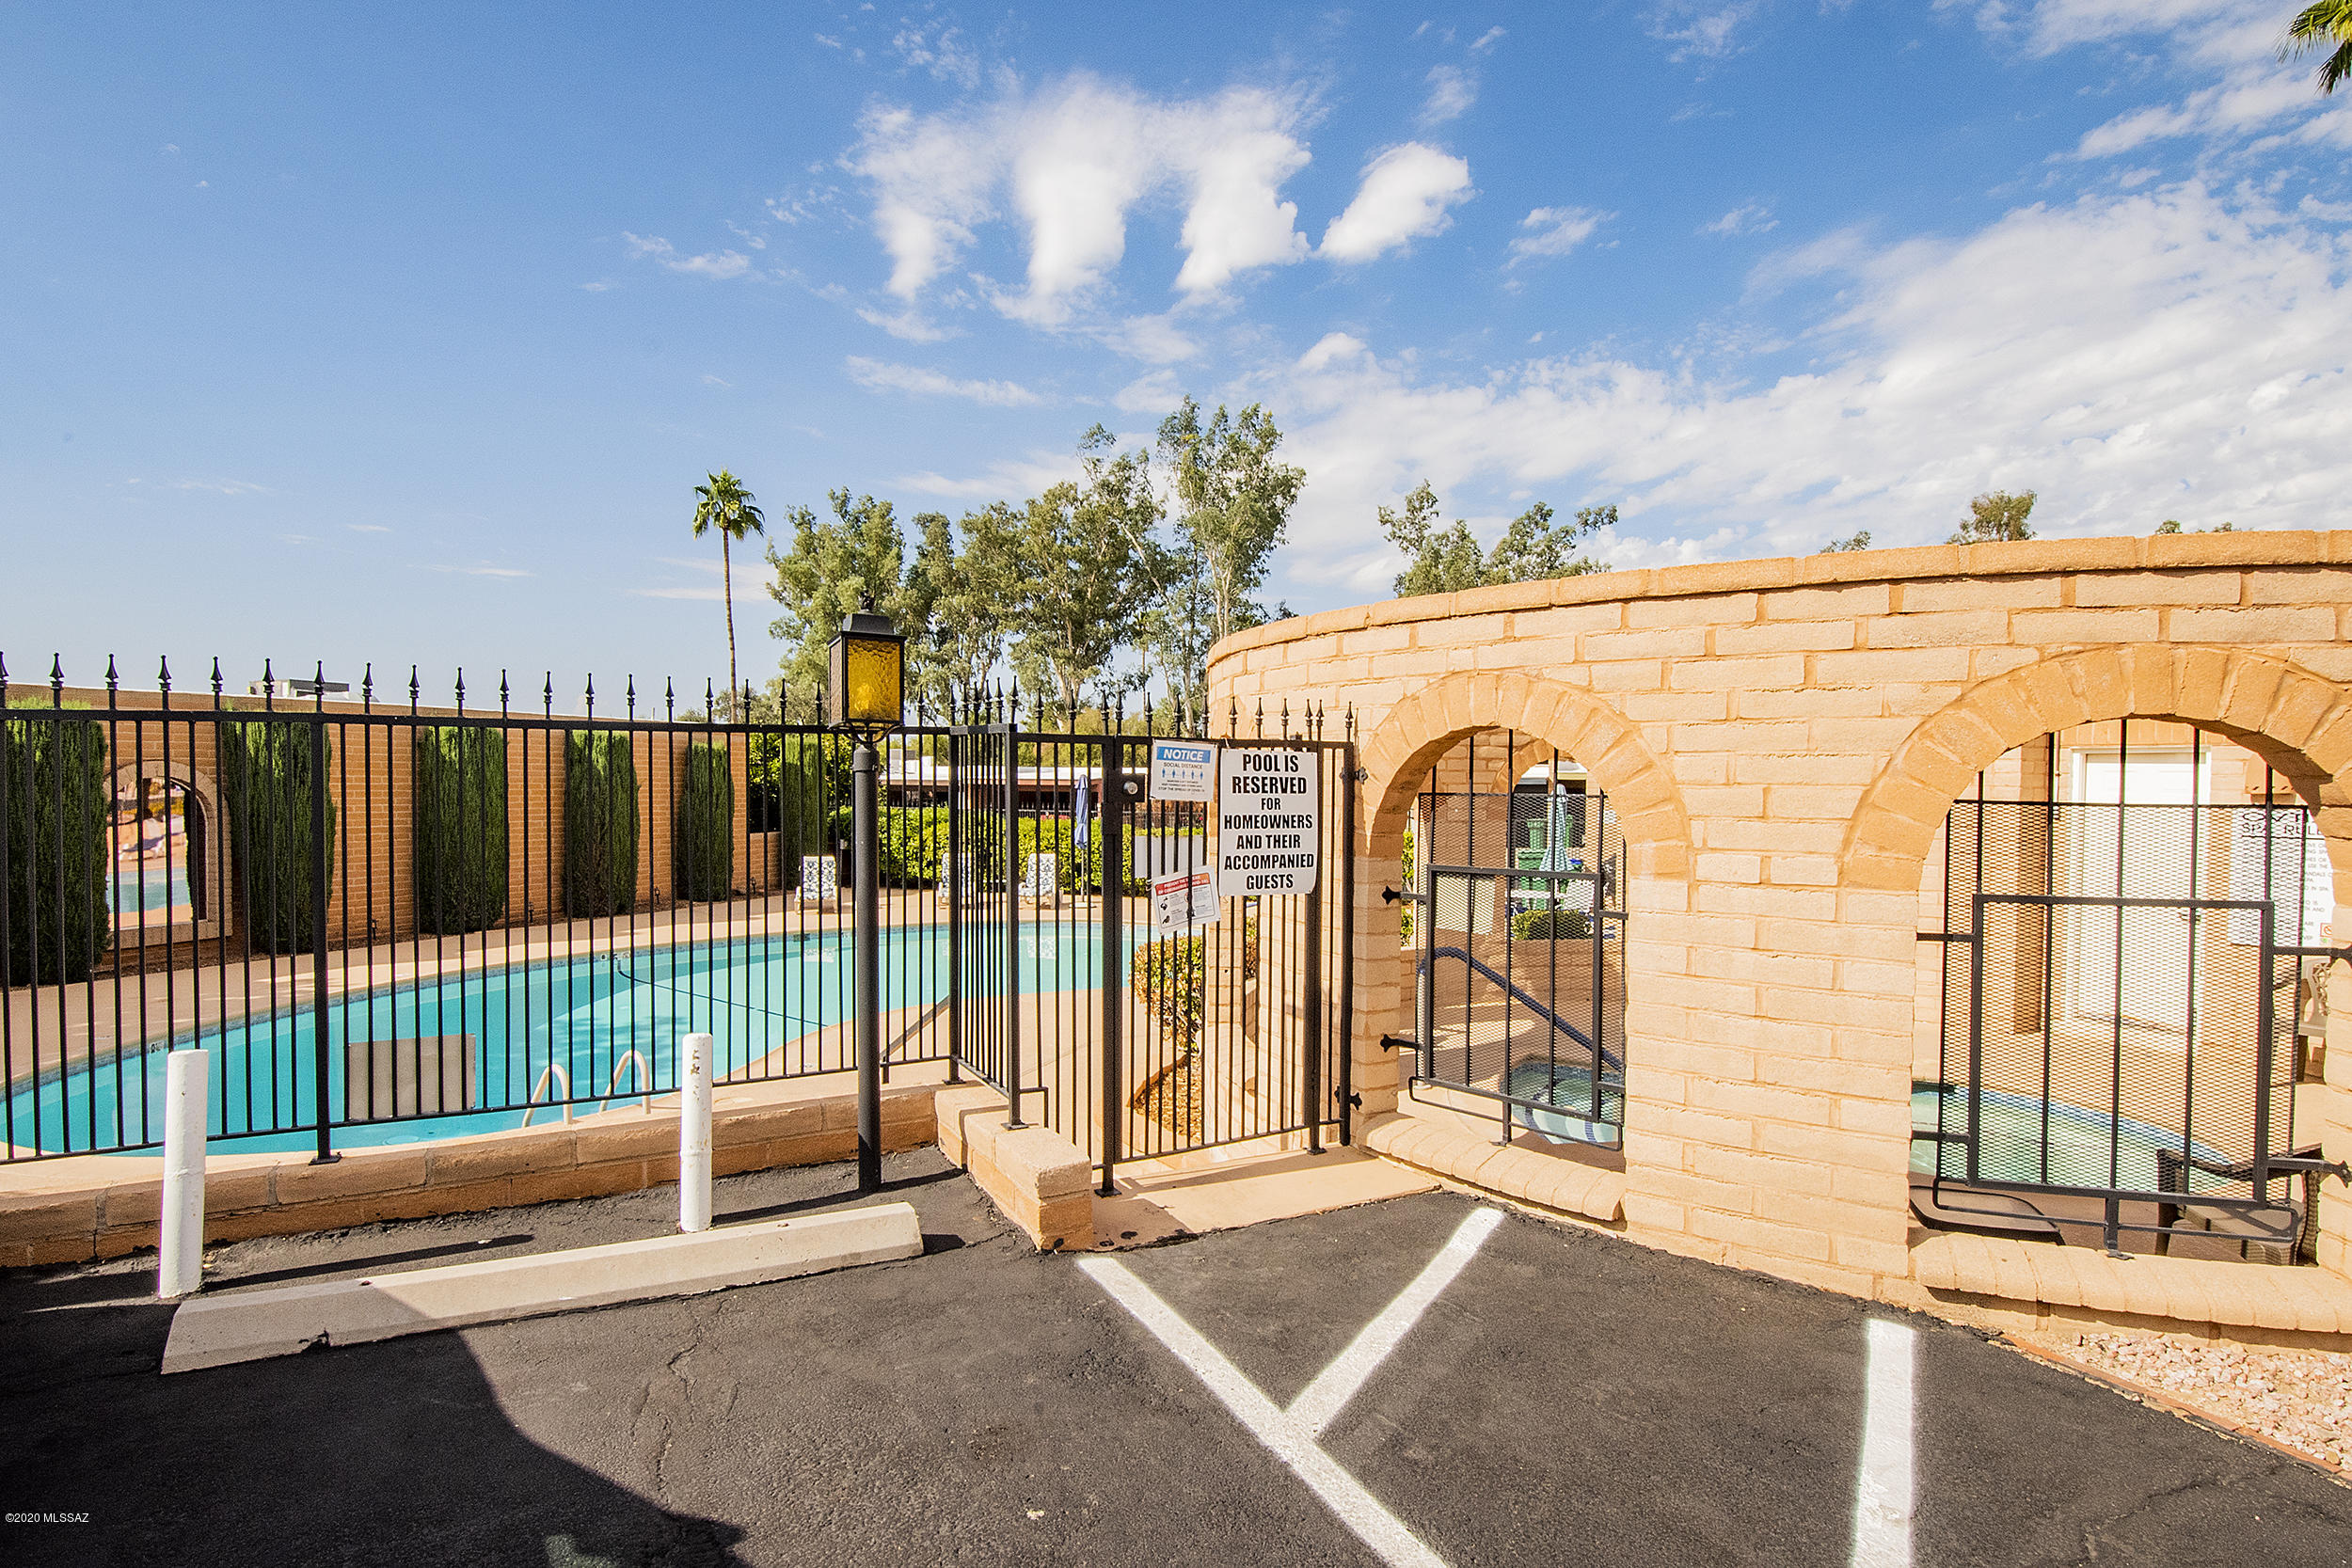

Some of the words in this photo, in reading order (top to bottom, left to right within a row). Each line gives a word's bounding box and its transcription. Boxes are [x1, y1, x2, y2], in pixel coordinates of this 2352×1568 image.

[1163, 749, 1204, 761] NOTICE
[1243, 753, 1280, 772] POOL
[1284, 754, 1299, 773] IS
[1232, 776, 1307, 794] RESERVED
[1261, 798, 1281, 811] FOR
[1224, 814, 1313, 830] HOMEOWNERS
[1236, 834, 1263, 849] AND
[1265, 834, 1300, 848] THEIR
[1224, 853, 1314, 870] ACCOMPANIED
[1246, 874, 1294, 890] GUESTS
